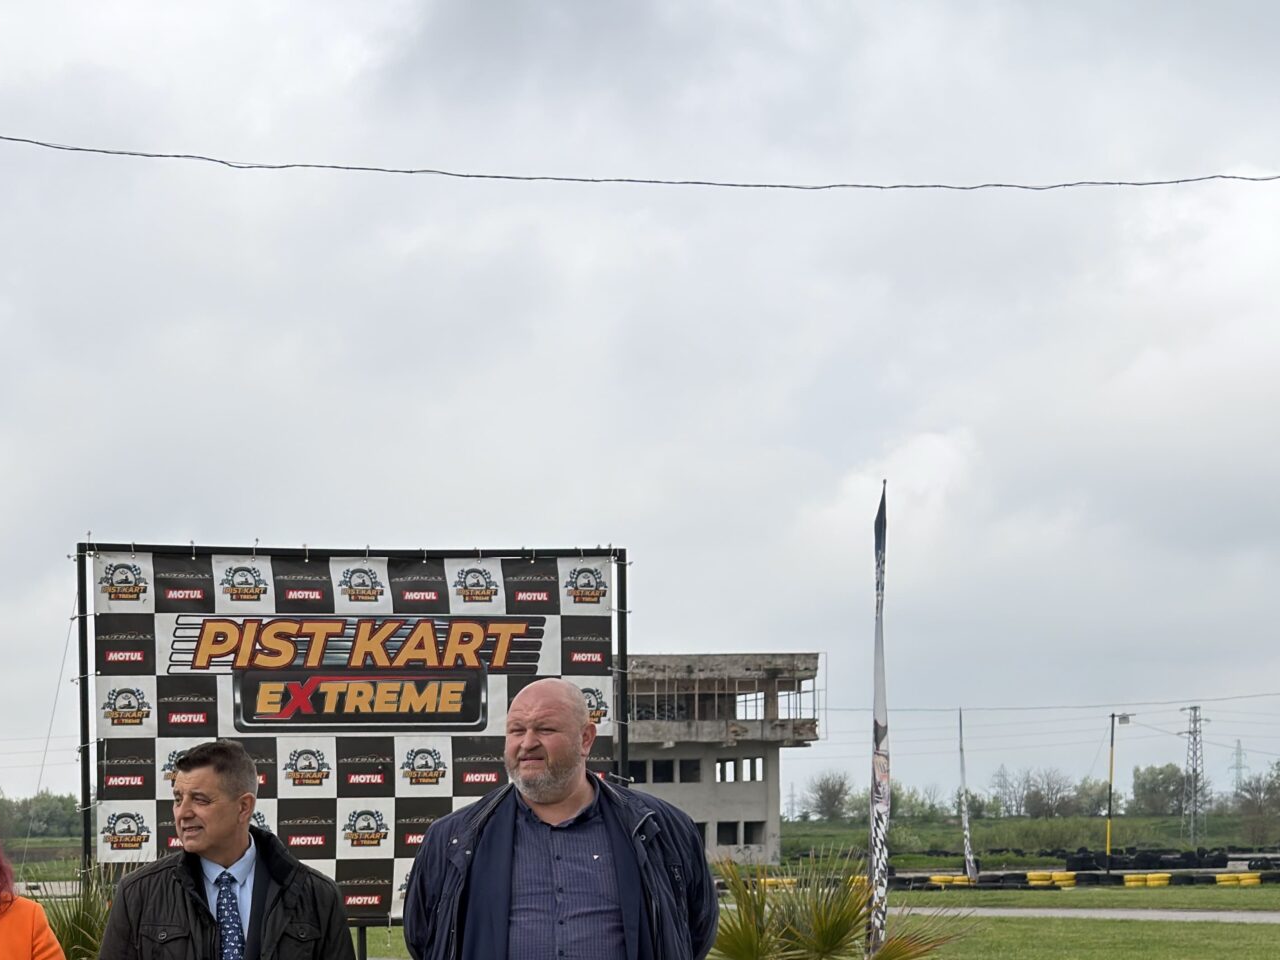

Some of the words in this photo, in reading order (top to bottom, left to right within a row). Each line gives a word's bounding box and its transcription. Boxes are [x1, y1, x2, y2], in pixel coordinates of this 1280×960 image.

[167, 590, 203, 599] MOTUL
[287, 591, 321, 599] MOTUL
[404, 592, 437, 600] MOTUL
[517, 592, 548, 600] MOTUL
[191, 618, 347, 670] PIST
[346, 618, 529, 669] KART
[108, 652, 143, 660] MOTUL
[572, 653, 602, 661] MOTUL
[253, 676, 468, 719] EXTREME
[170, 714, 205, 723] MOTUL
[108, 777, 143, 785] MOTUL
[349, 775, 382, 783] MOTUL
[465, 774, 497, 782] MOTUL
[290, 836, 324, 845] MOTUL
[346, 896, 381, 905] MOTUL
